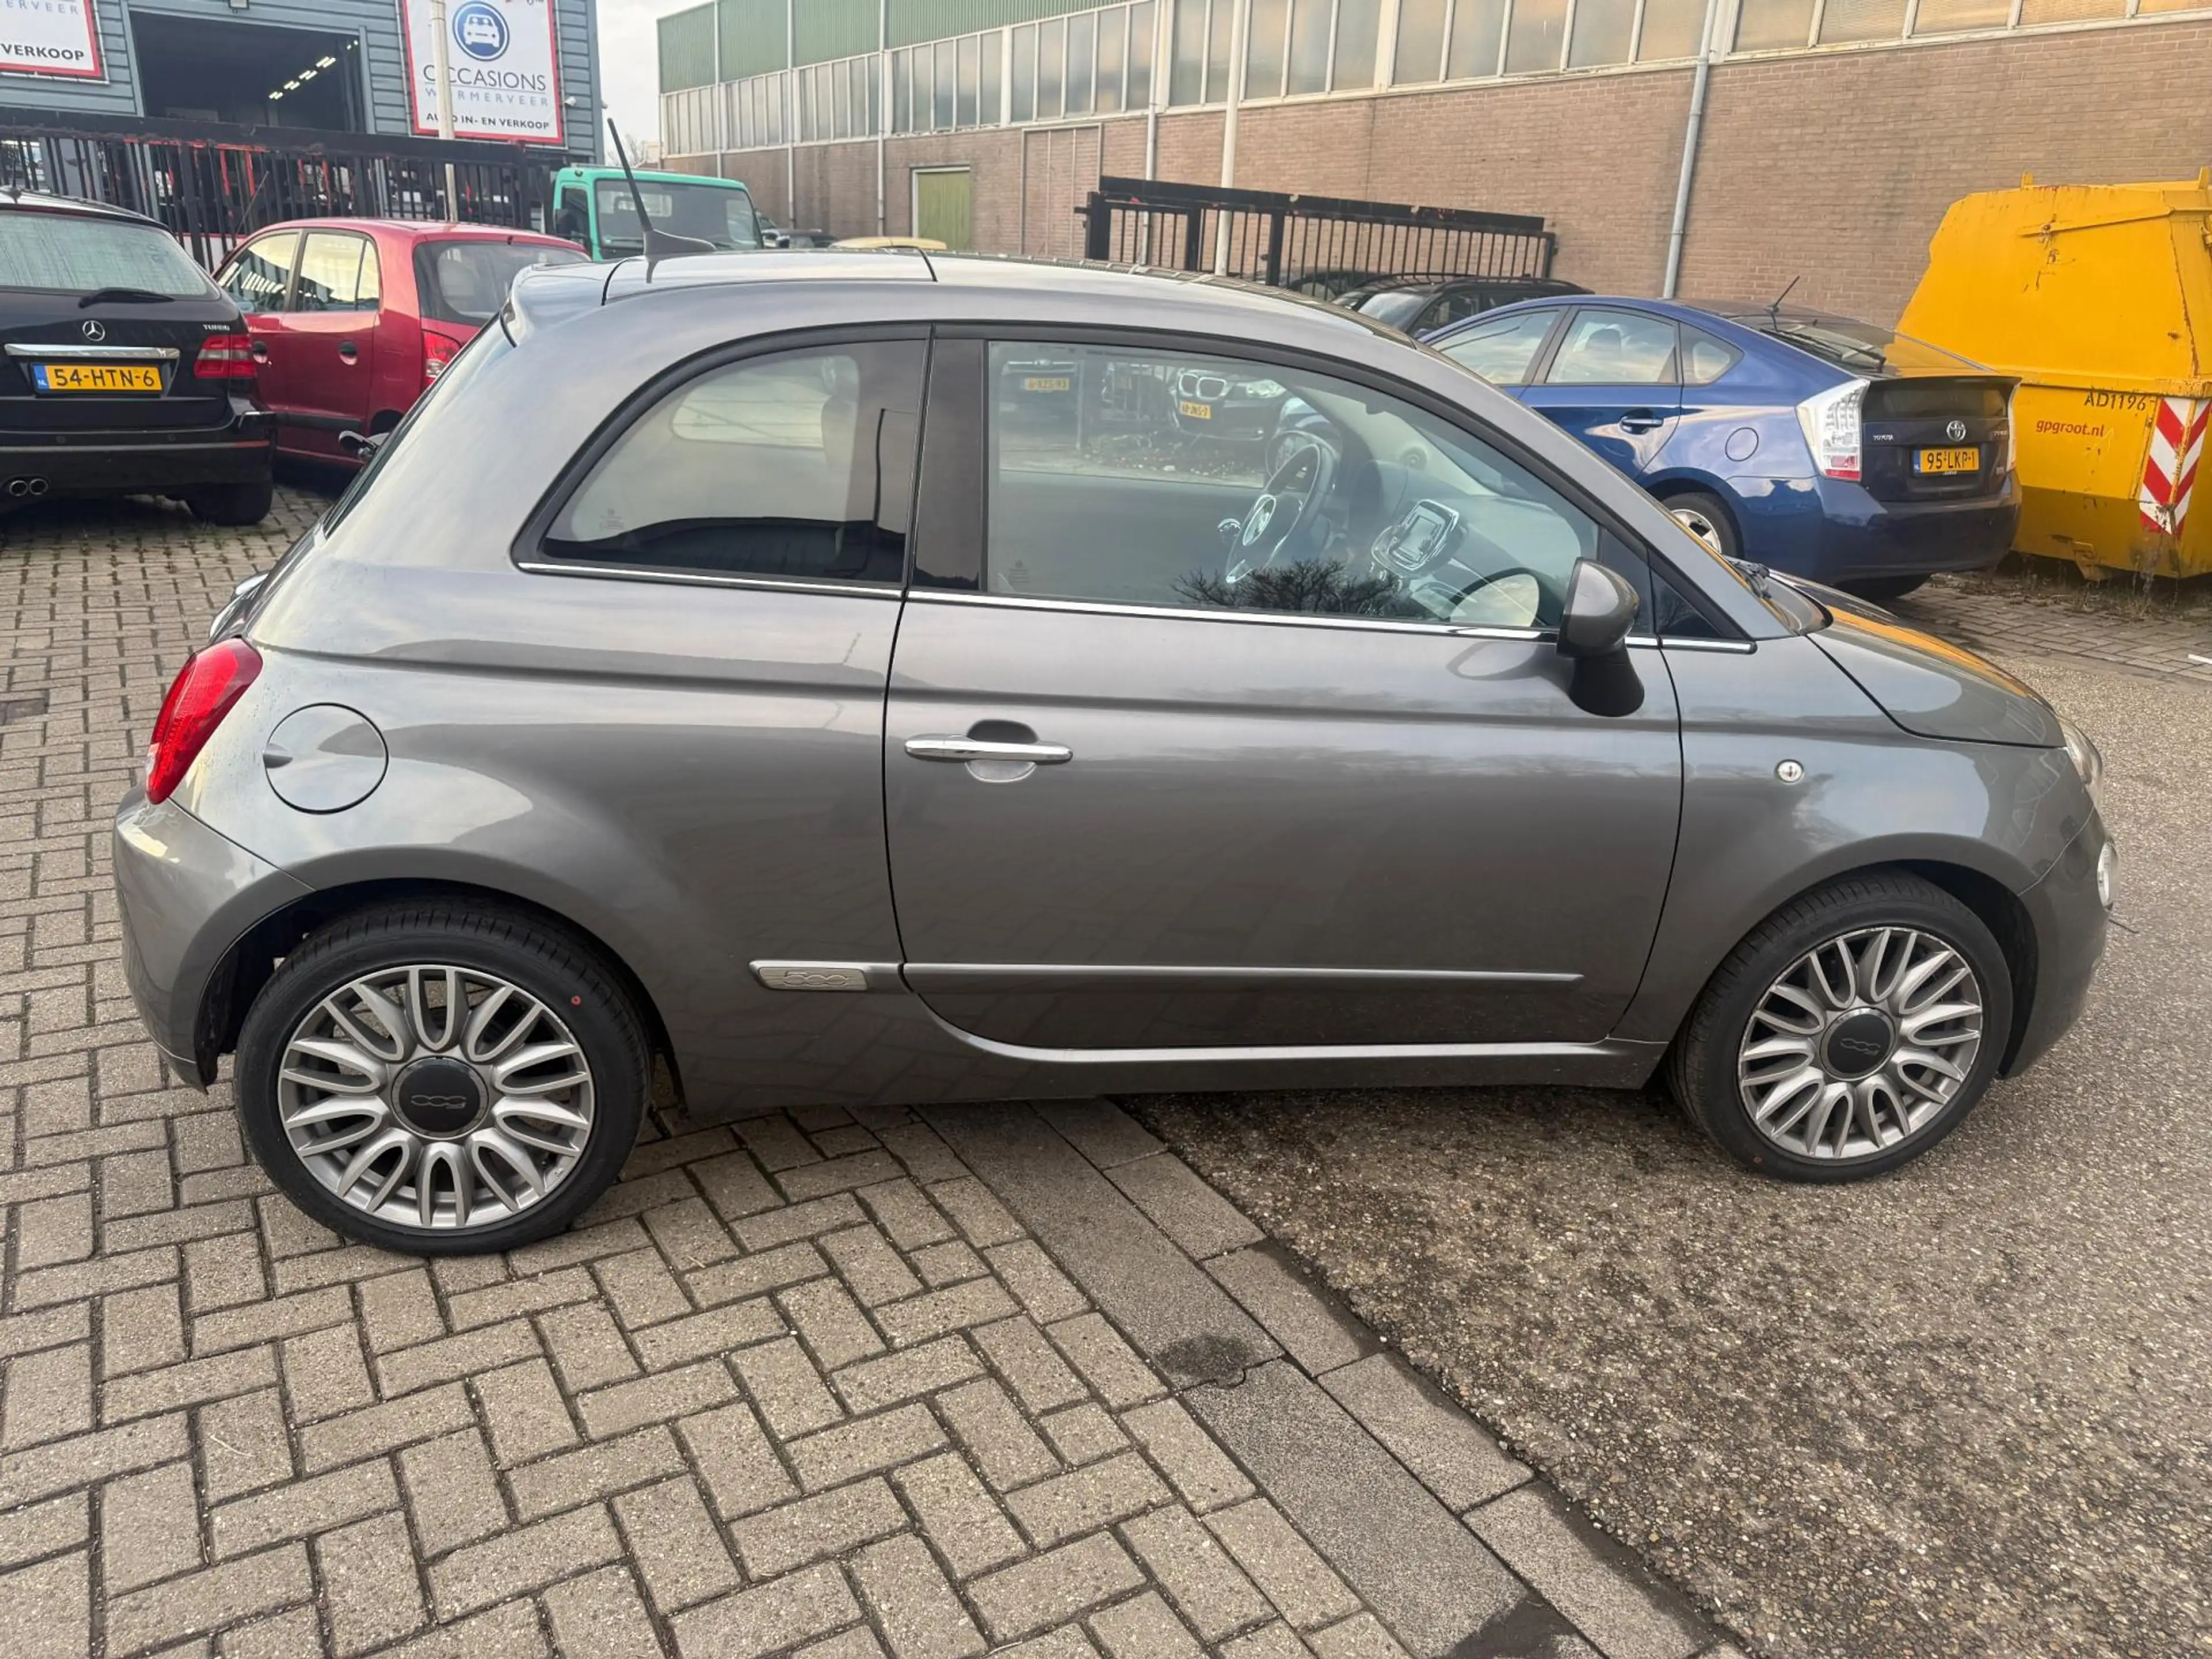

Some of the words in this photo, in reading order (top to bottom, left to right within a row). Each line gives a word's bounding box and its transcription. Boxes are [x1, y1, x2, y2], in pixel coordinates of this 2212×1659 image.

[1, 43, 85, 60] VERKOOP
[425, 88, 548, 107] WRMERVEER
[461, 115, 478, 124] IN-
[482, 117, 497, 126] EN
[499, 118, 550, 130] VERKOOP
[54, 369, 155, 387] 54-HTN-6
[2084, 391, 2146, 411] AD1196
[2036, 420, 2105, 437] gpgroot.nl
[1927, 452, 1975, 470] 95-LKP-1
[783, 970, 849, 987] 500
